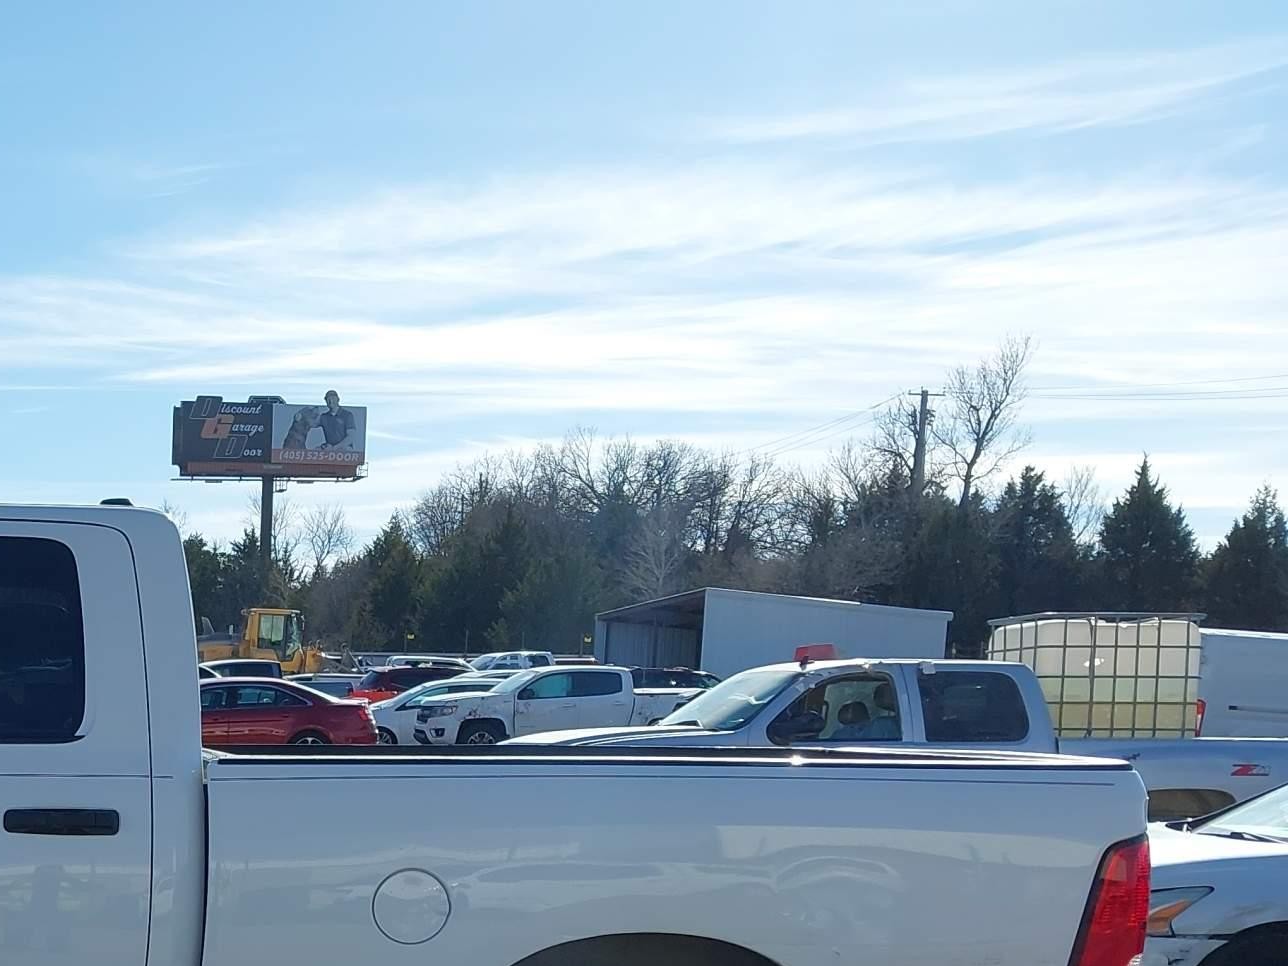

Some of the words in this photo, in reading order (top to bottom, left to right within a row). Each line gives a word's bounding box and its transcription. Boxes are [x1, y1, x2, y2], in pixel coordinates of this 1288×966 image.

[189, 396, 262, 420] Discount
[200, 414, 264, 439] Garage
[213, 433, 262, 459] Door
[279, 450, 304, 461] (405)
